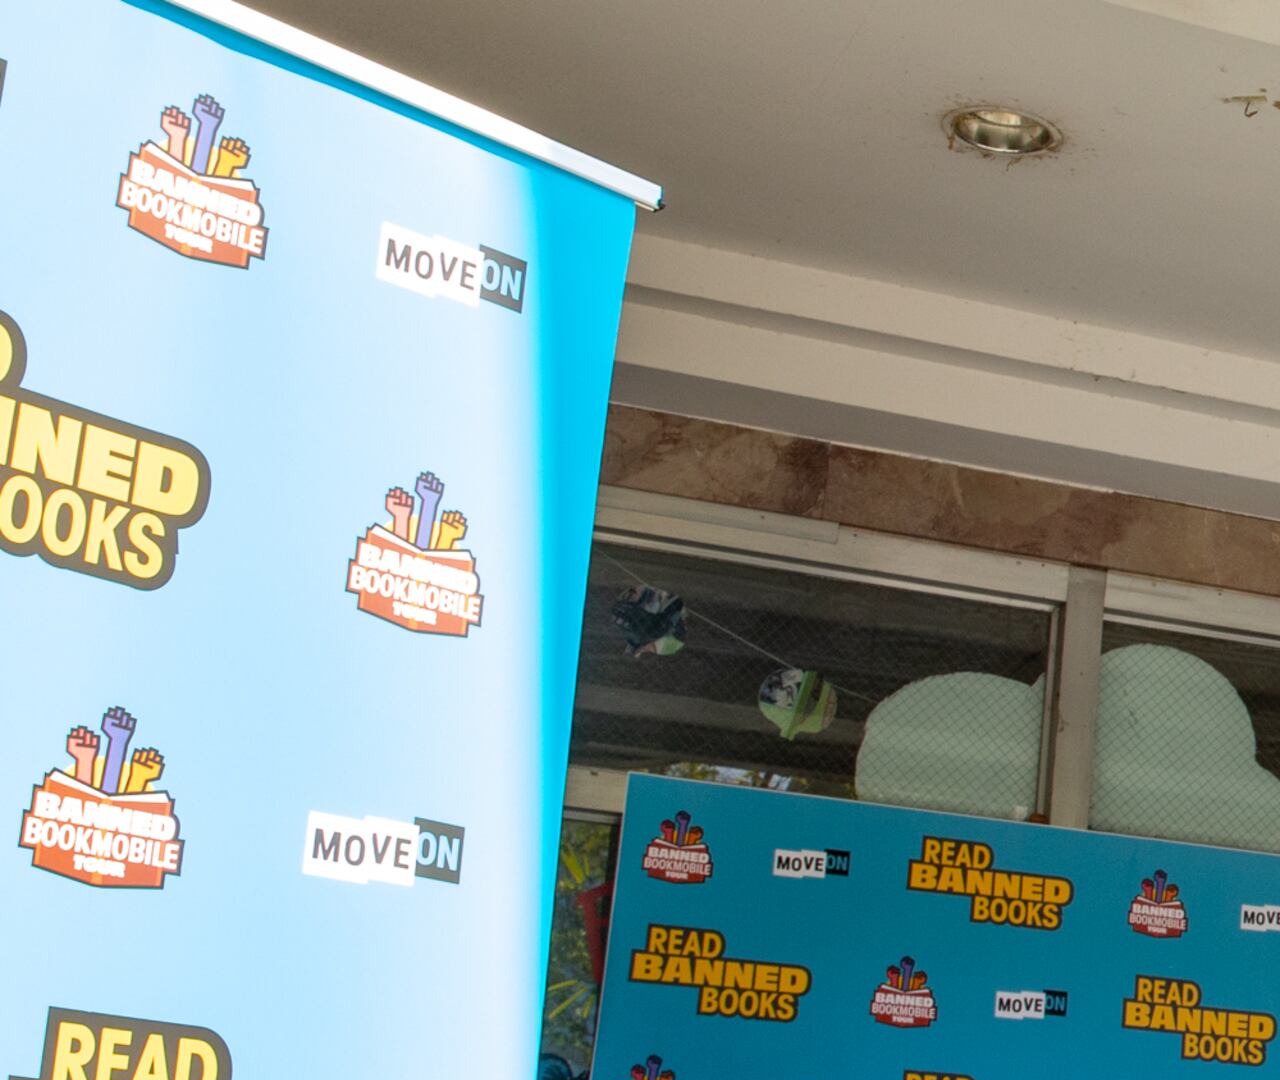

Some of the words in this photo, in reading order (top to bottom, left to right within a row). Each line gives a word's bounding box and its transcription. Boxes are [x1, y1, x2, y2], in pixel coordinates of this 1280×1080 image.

[130, 157, 261, 226] BANNED
[119, 180, 264, 256] BOOKMOBILE
[0, 398, 200, 516] NED
[358, 543, 477, 597] BANNED
[348, 563, 480, 622] BOOKMOBILE
[34, 790, 176, 841] BANNED
[23, 816, 179, 870] BOOKMOBILE
[648, 847, 708, 863] BANNED
[924, 839, 991, 868] READ
[644, 858, 711, 876] BOOKMOBILE
[910, 864, 1071, 904] BANNED
[973, 897, 1060, 927] BOOKS
[648, 927, 722, 956] READ
[631, 953, 809, 993] BANNED
[1137, 978, 1198, 1006] READ
[700, 989, 795, 1020] BOOKS
[1124, 1002, 1275, 1040] BANNED
[1184, 1034, 1263, 1064] BOOKS
